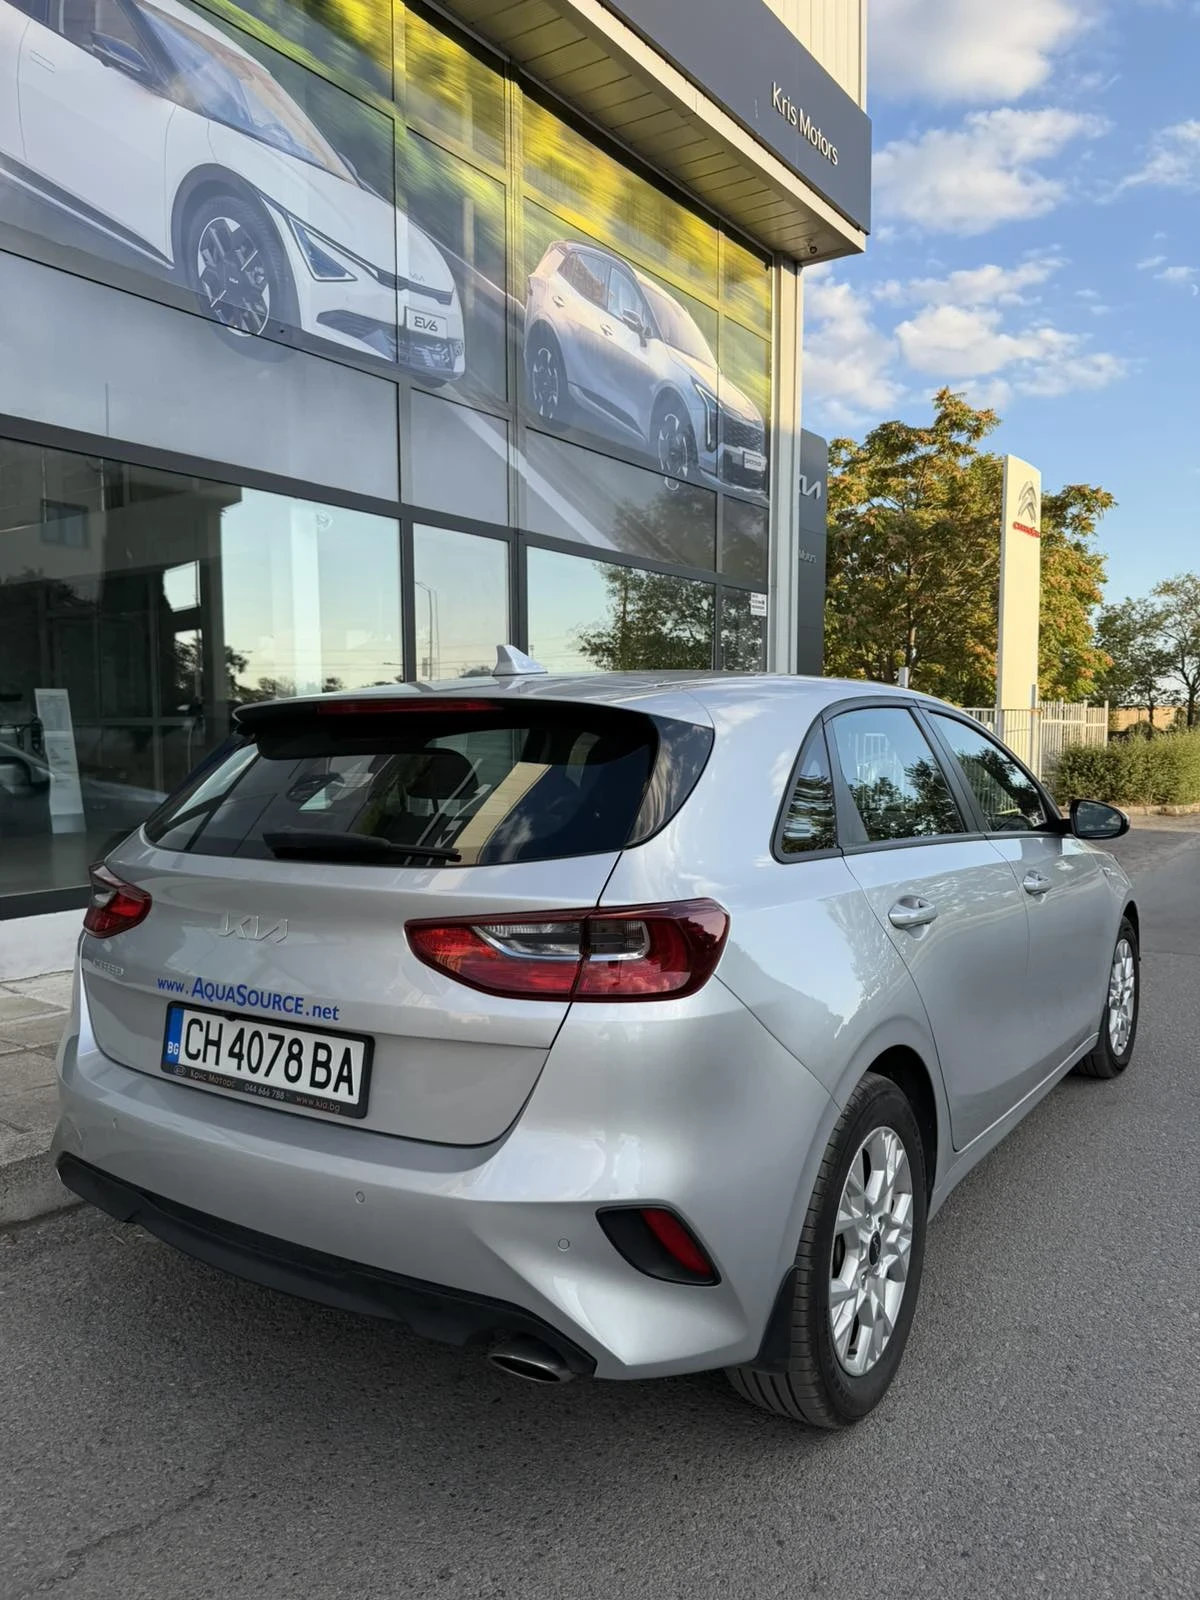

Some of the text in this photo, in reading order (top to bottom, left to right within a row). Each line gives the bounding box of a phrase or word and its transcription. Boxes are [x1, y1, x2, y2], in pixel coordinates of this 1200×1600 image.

[773, 81, 839, 166] Kris Motors
[414, 316, 438, 332] EV6
[218, 911, 288, 944] KIA
[167, 1041, 180, 1055] BG
